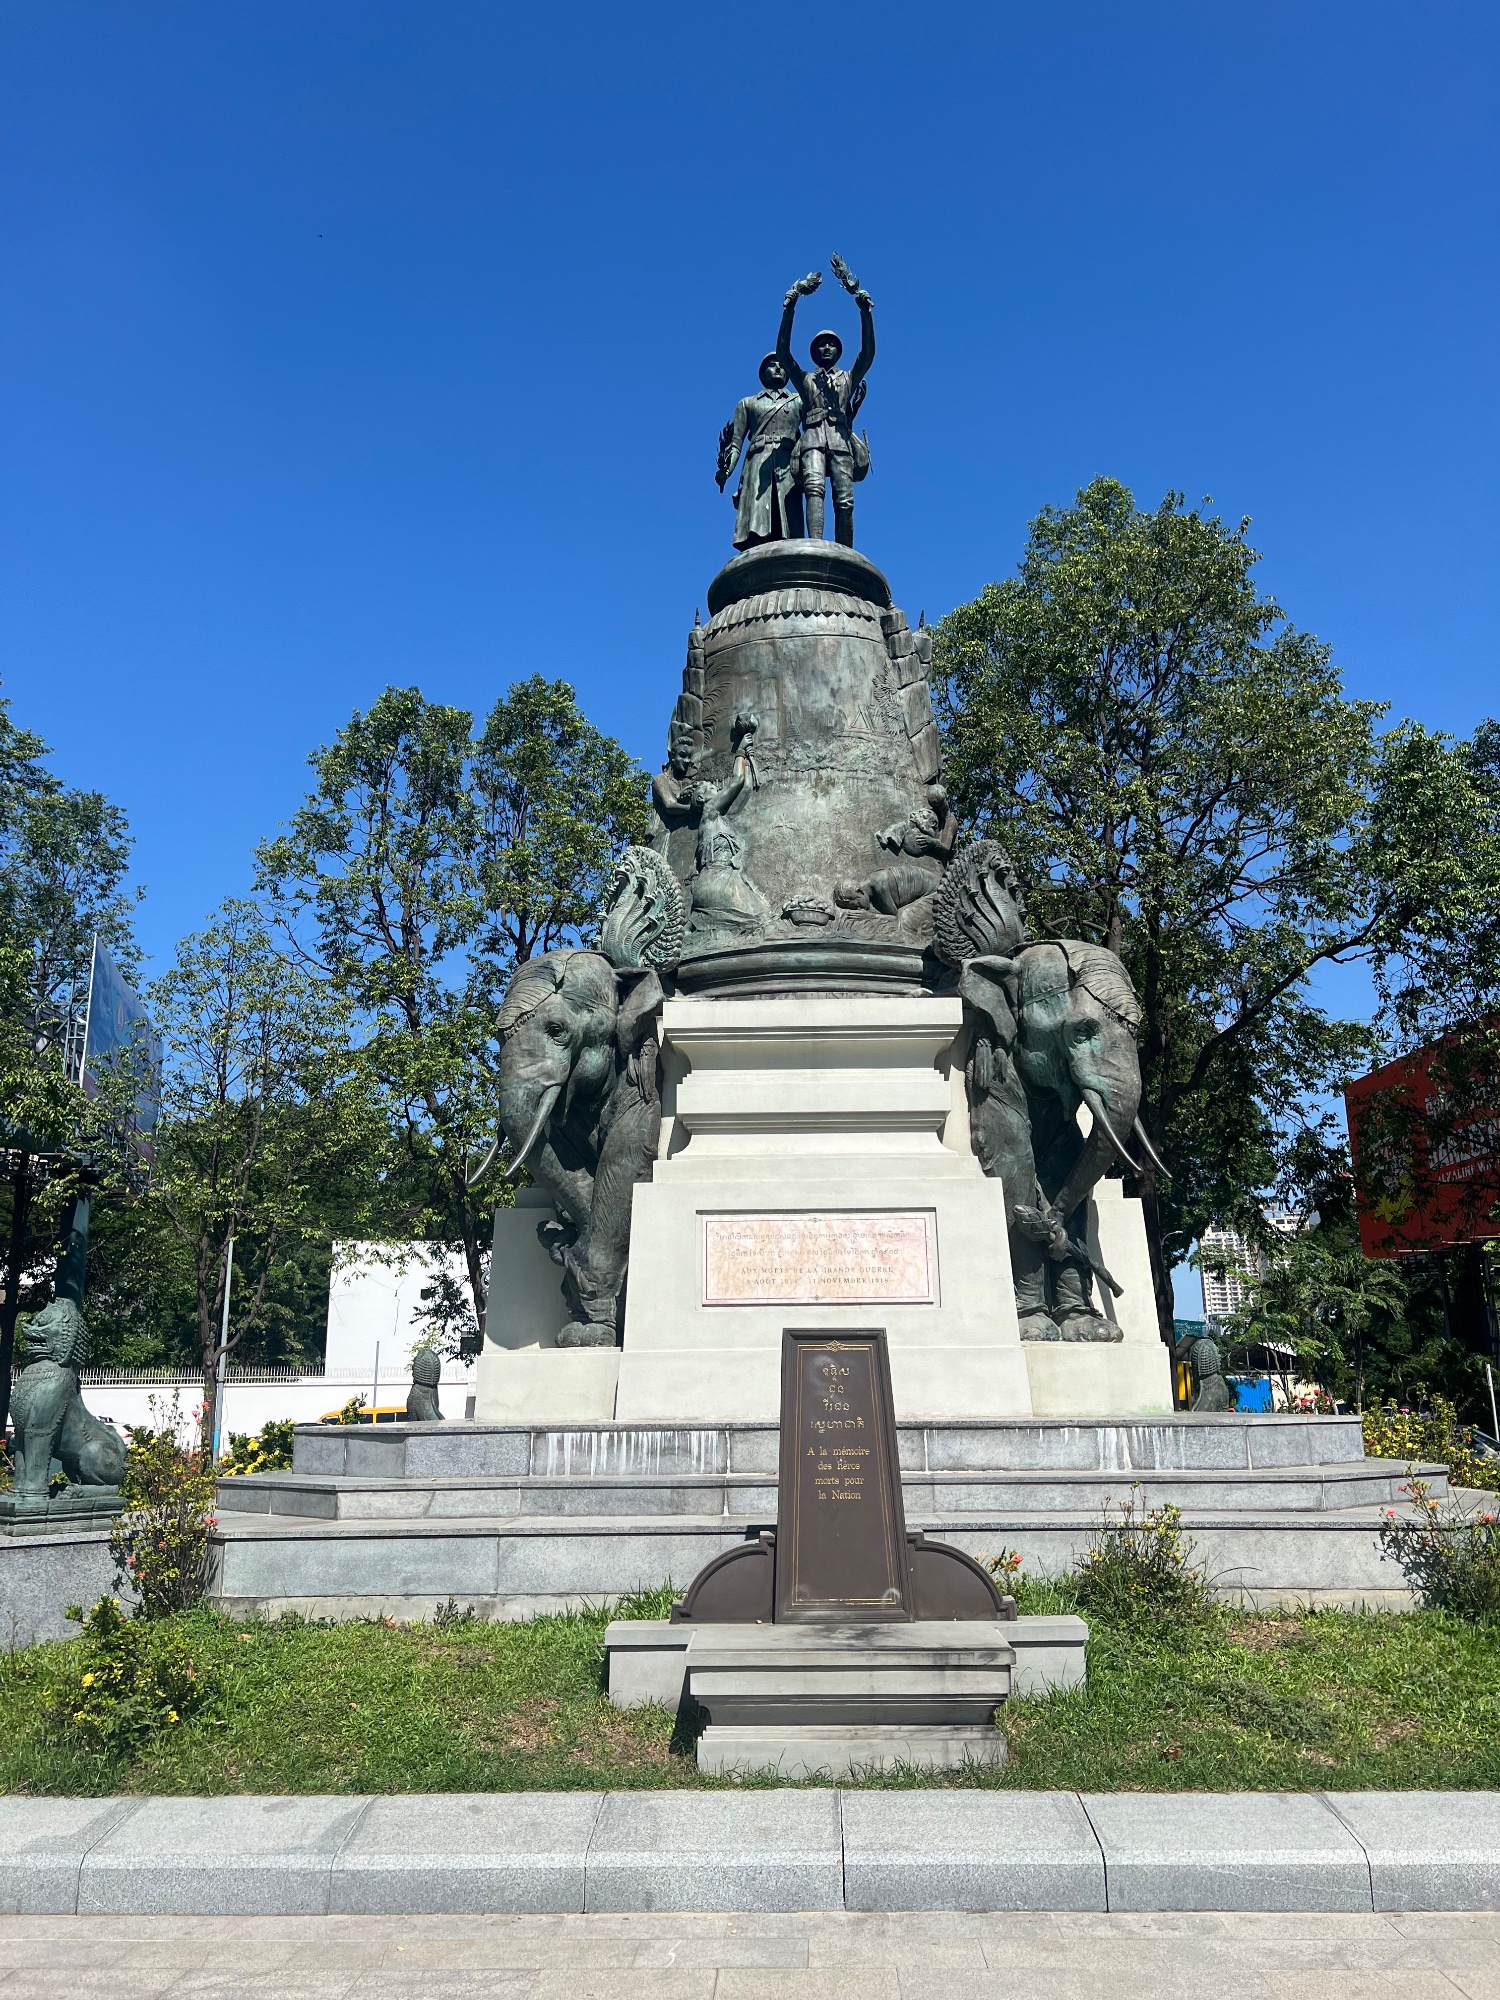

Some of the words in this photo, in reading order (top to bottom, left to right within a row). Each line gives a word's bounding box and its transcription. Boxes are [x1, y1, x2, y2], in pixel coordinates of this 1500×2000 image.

[821, 1266, 856, 1274] GRANDE
[806, 1446, 815, 1456] A
[819, 1445, 828, 1456] la
[832, 1446, 871, 1456] mémoire
[817, 1460, 833, 1471] des
[836, 1460, 861, 1470] héros
[814, 1476, 840, 1485] morts
[844, 1477, 865, 1487] pour
[818, 1489, 827, 1500] la
[831, 1489, 862, 1500] Nation
